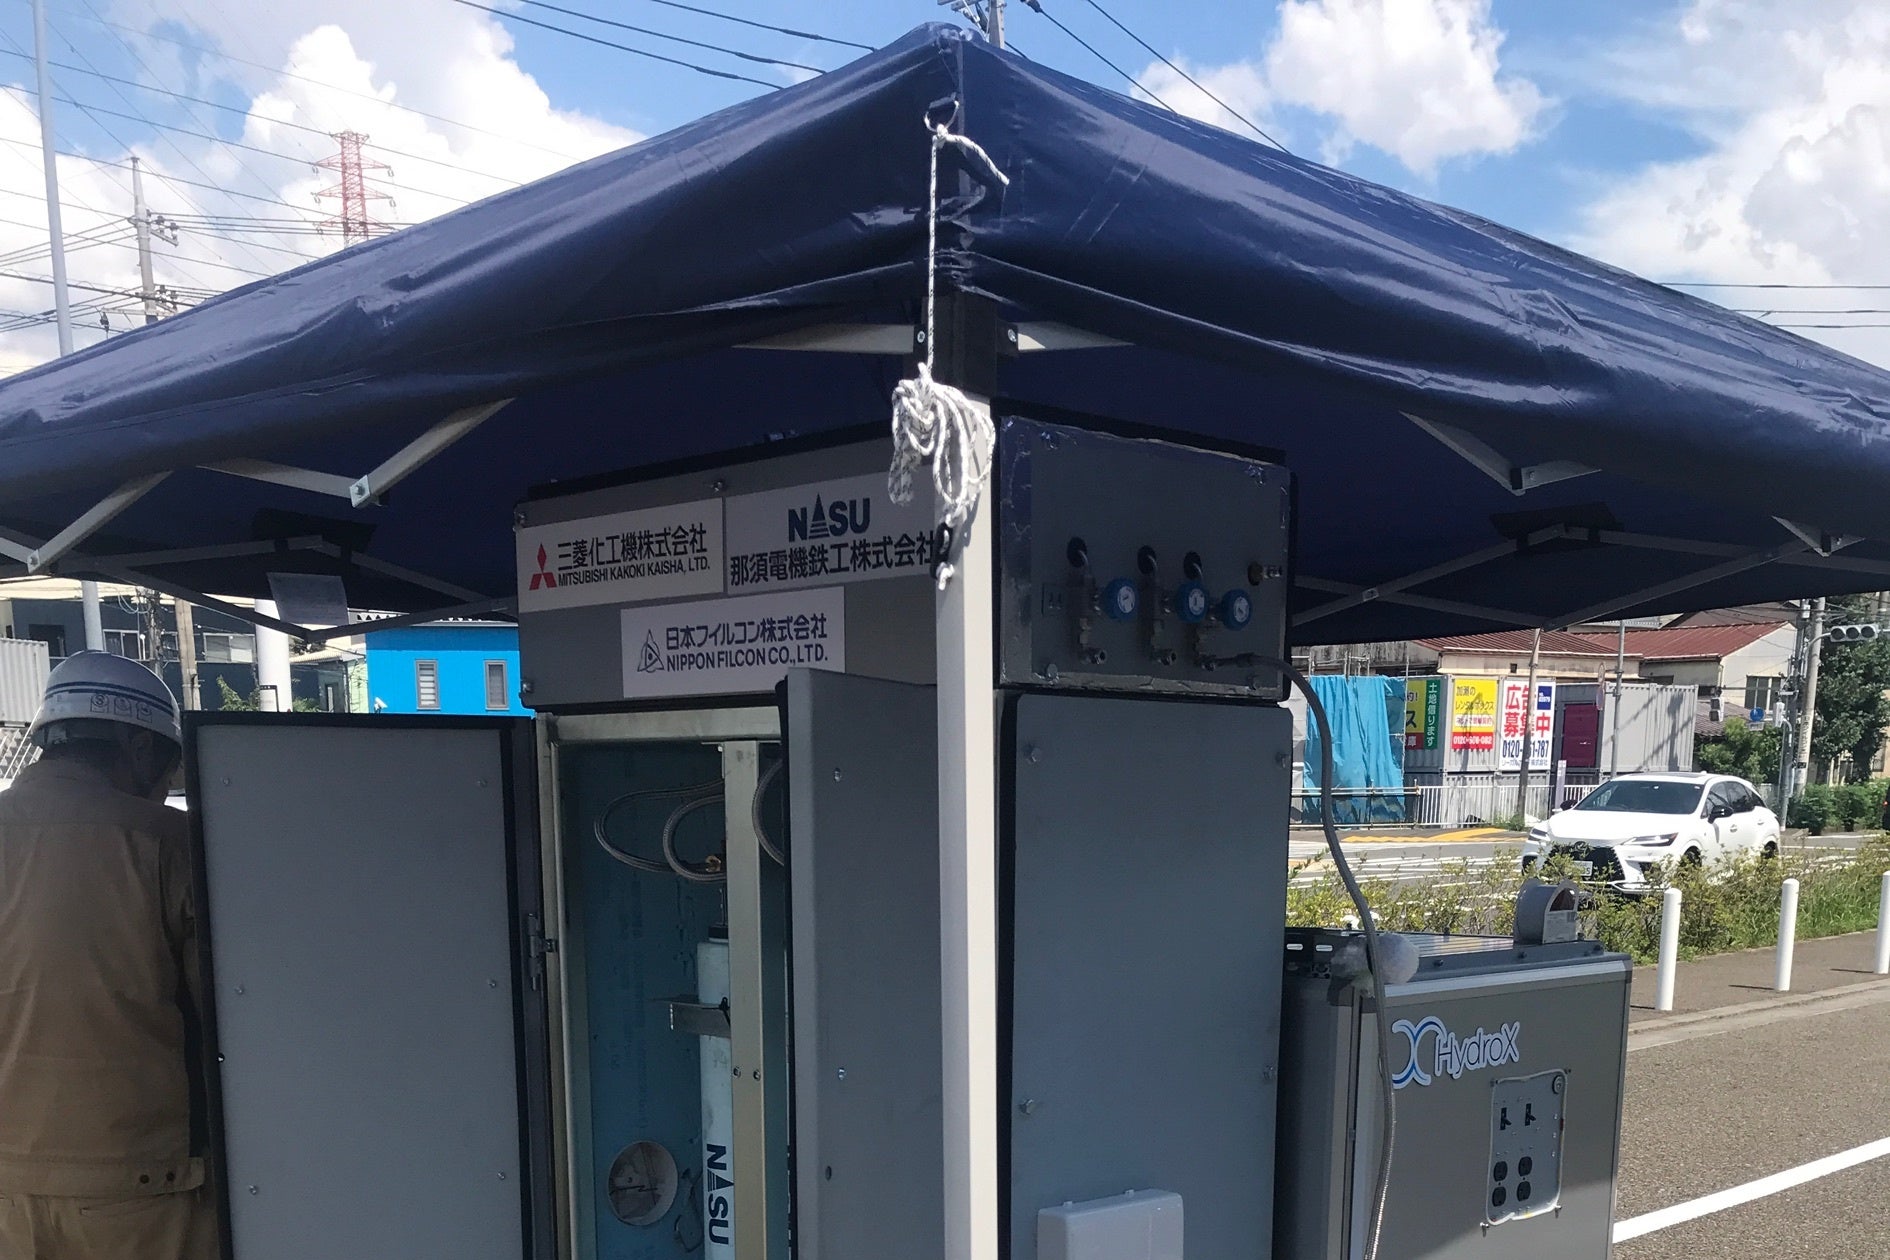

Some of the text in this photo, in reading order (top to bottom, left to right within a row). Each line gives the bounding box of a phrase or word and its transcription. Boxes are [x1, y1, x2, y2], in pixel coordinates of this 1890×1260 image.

[788, 493, 870, 542] NASU
[558, 522, 707, 571] 三菱化工機株式会社
[731, 530, 934, 586] 那須電機鉄工株式会社
[558, 557, 711, 586] MITSUBISHI KAKOKI KAISHA, LTD.
[666, 652, 715, 672] NIPPON
[717, 648, 767, 668] FILCON
[1436, 1022, 1519, 1079] HydroX
[706, 1143, 735, 1245] NASU
